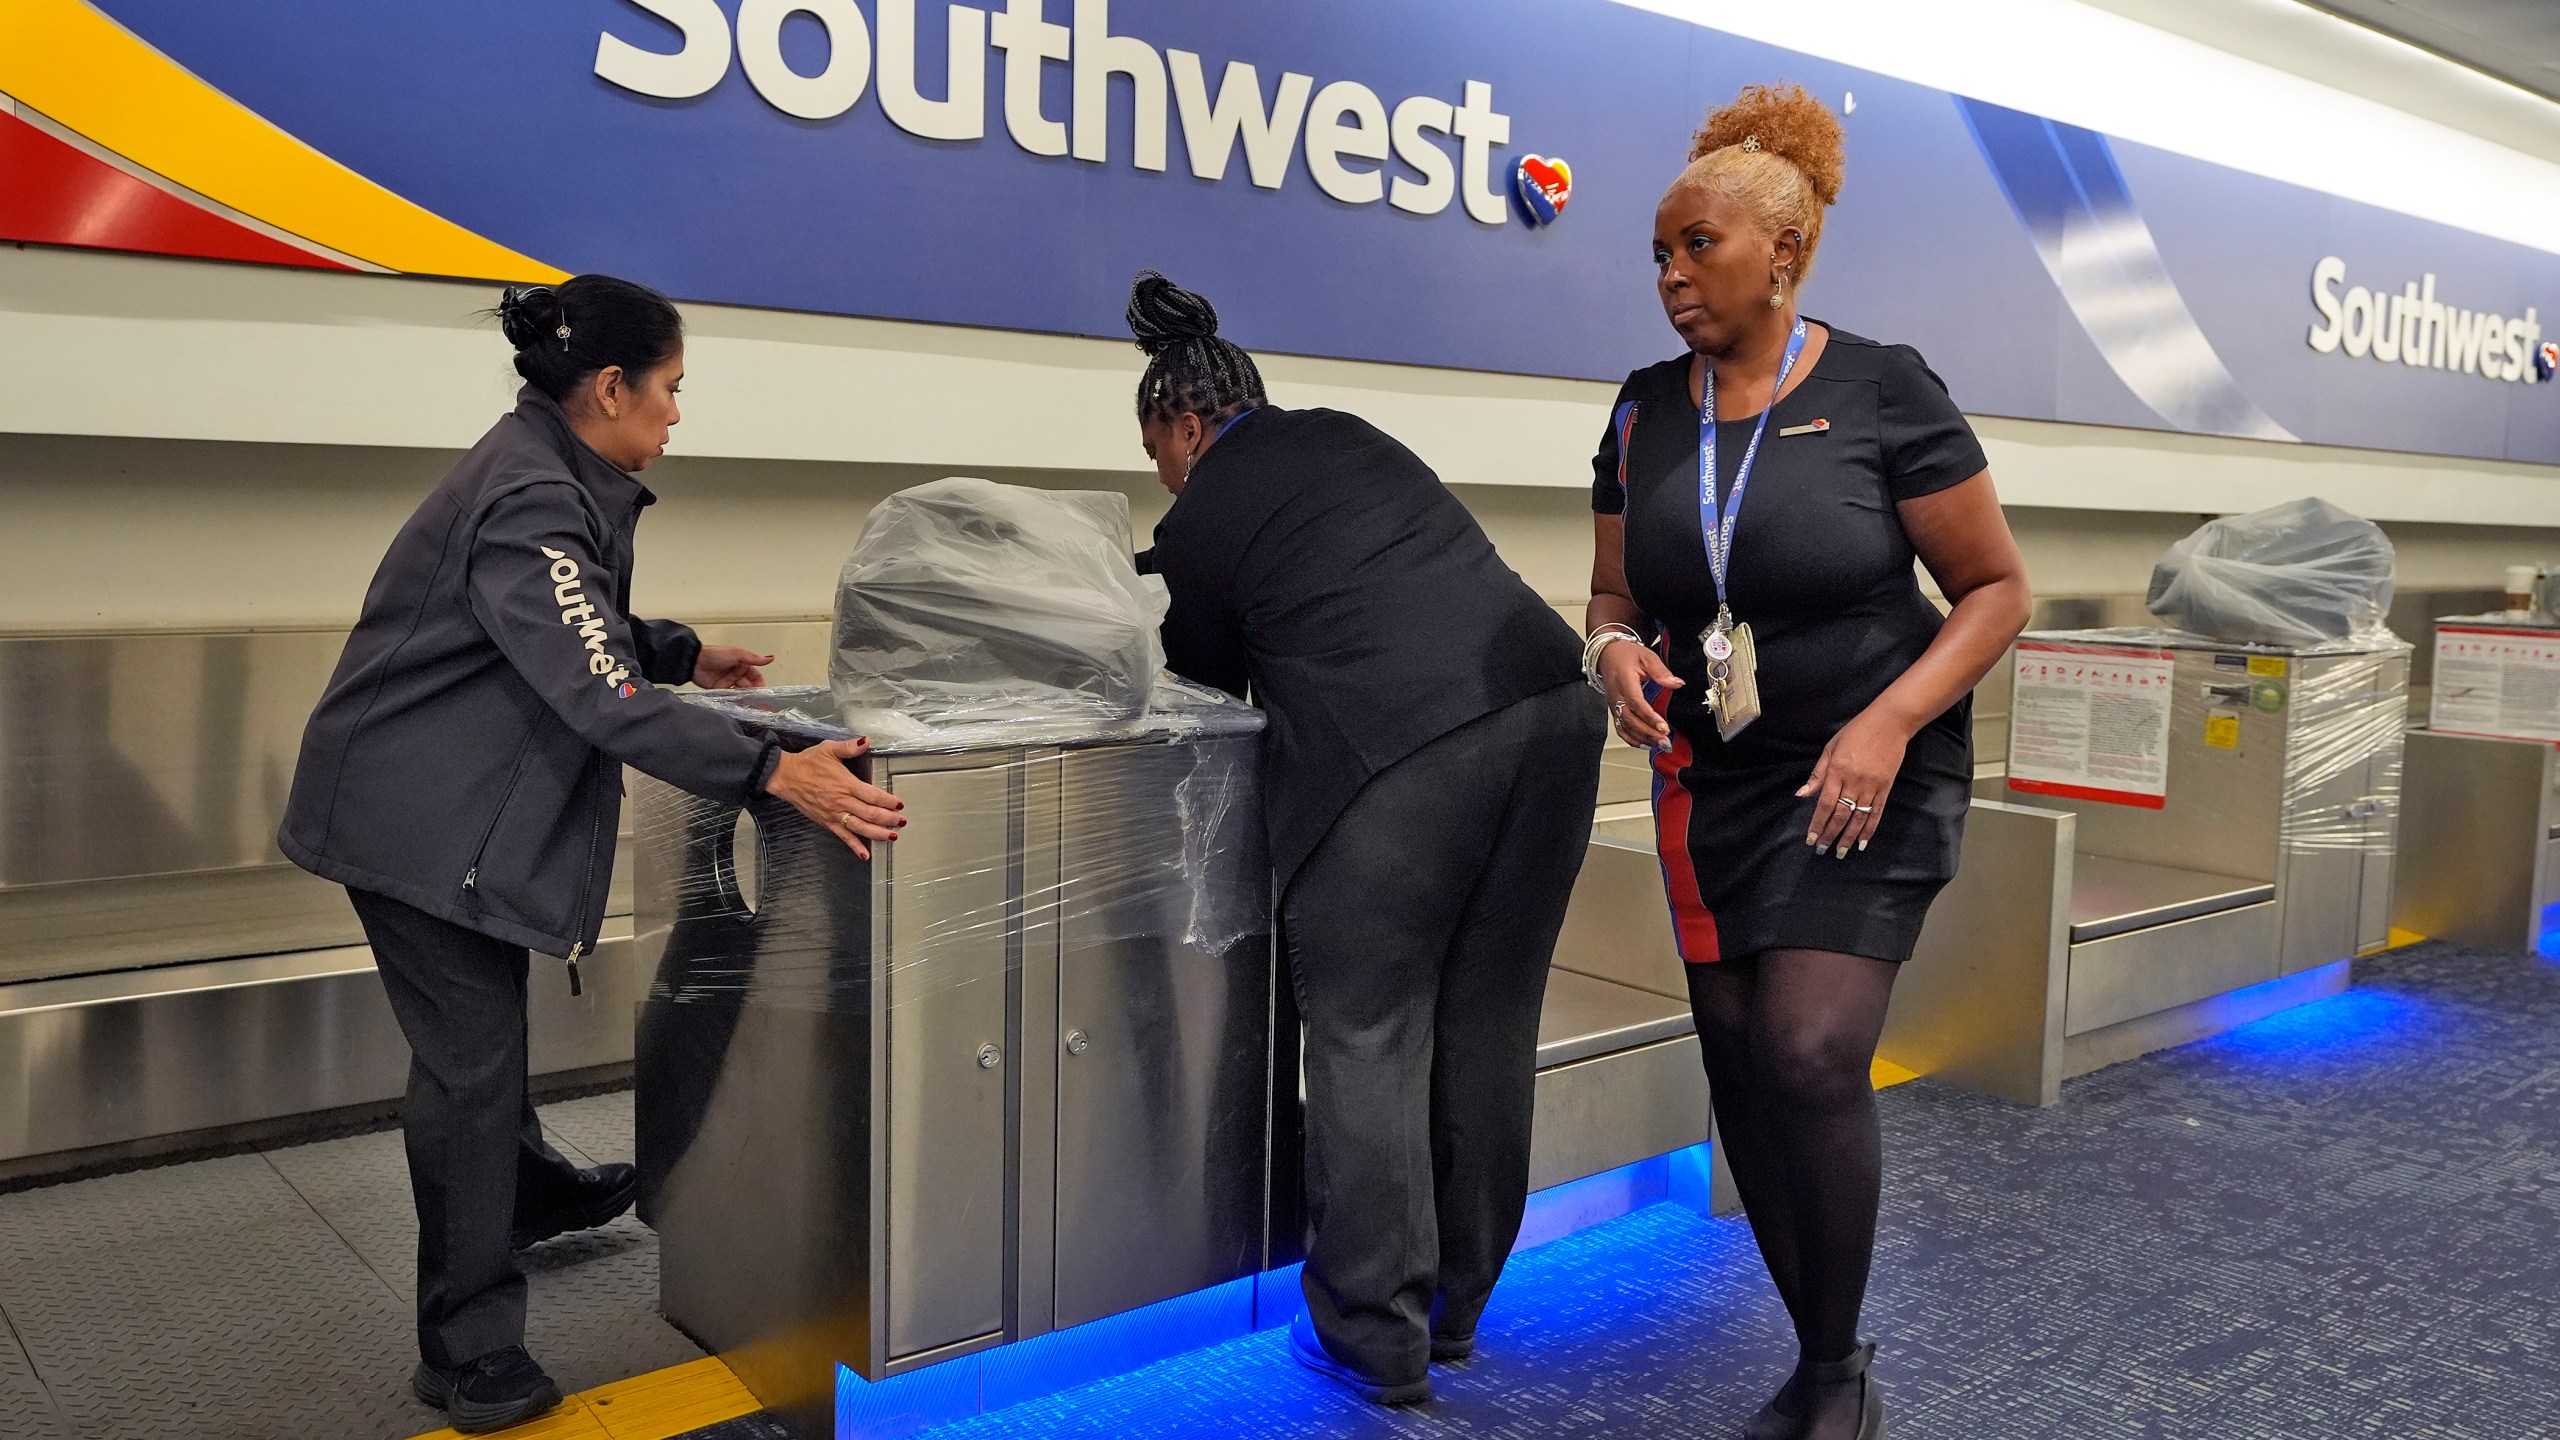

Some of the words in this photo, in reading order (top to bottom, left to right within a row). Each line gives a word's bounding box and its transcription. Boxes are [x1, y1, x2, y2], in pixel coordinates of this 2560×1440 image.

[2307, 256, 2541, 384] Southwest
[1702, 444, 1715, 505] Southwest
[1733, 428, 1763, 492] Southwest
